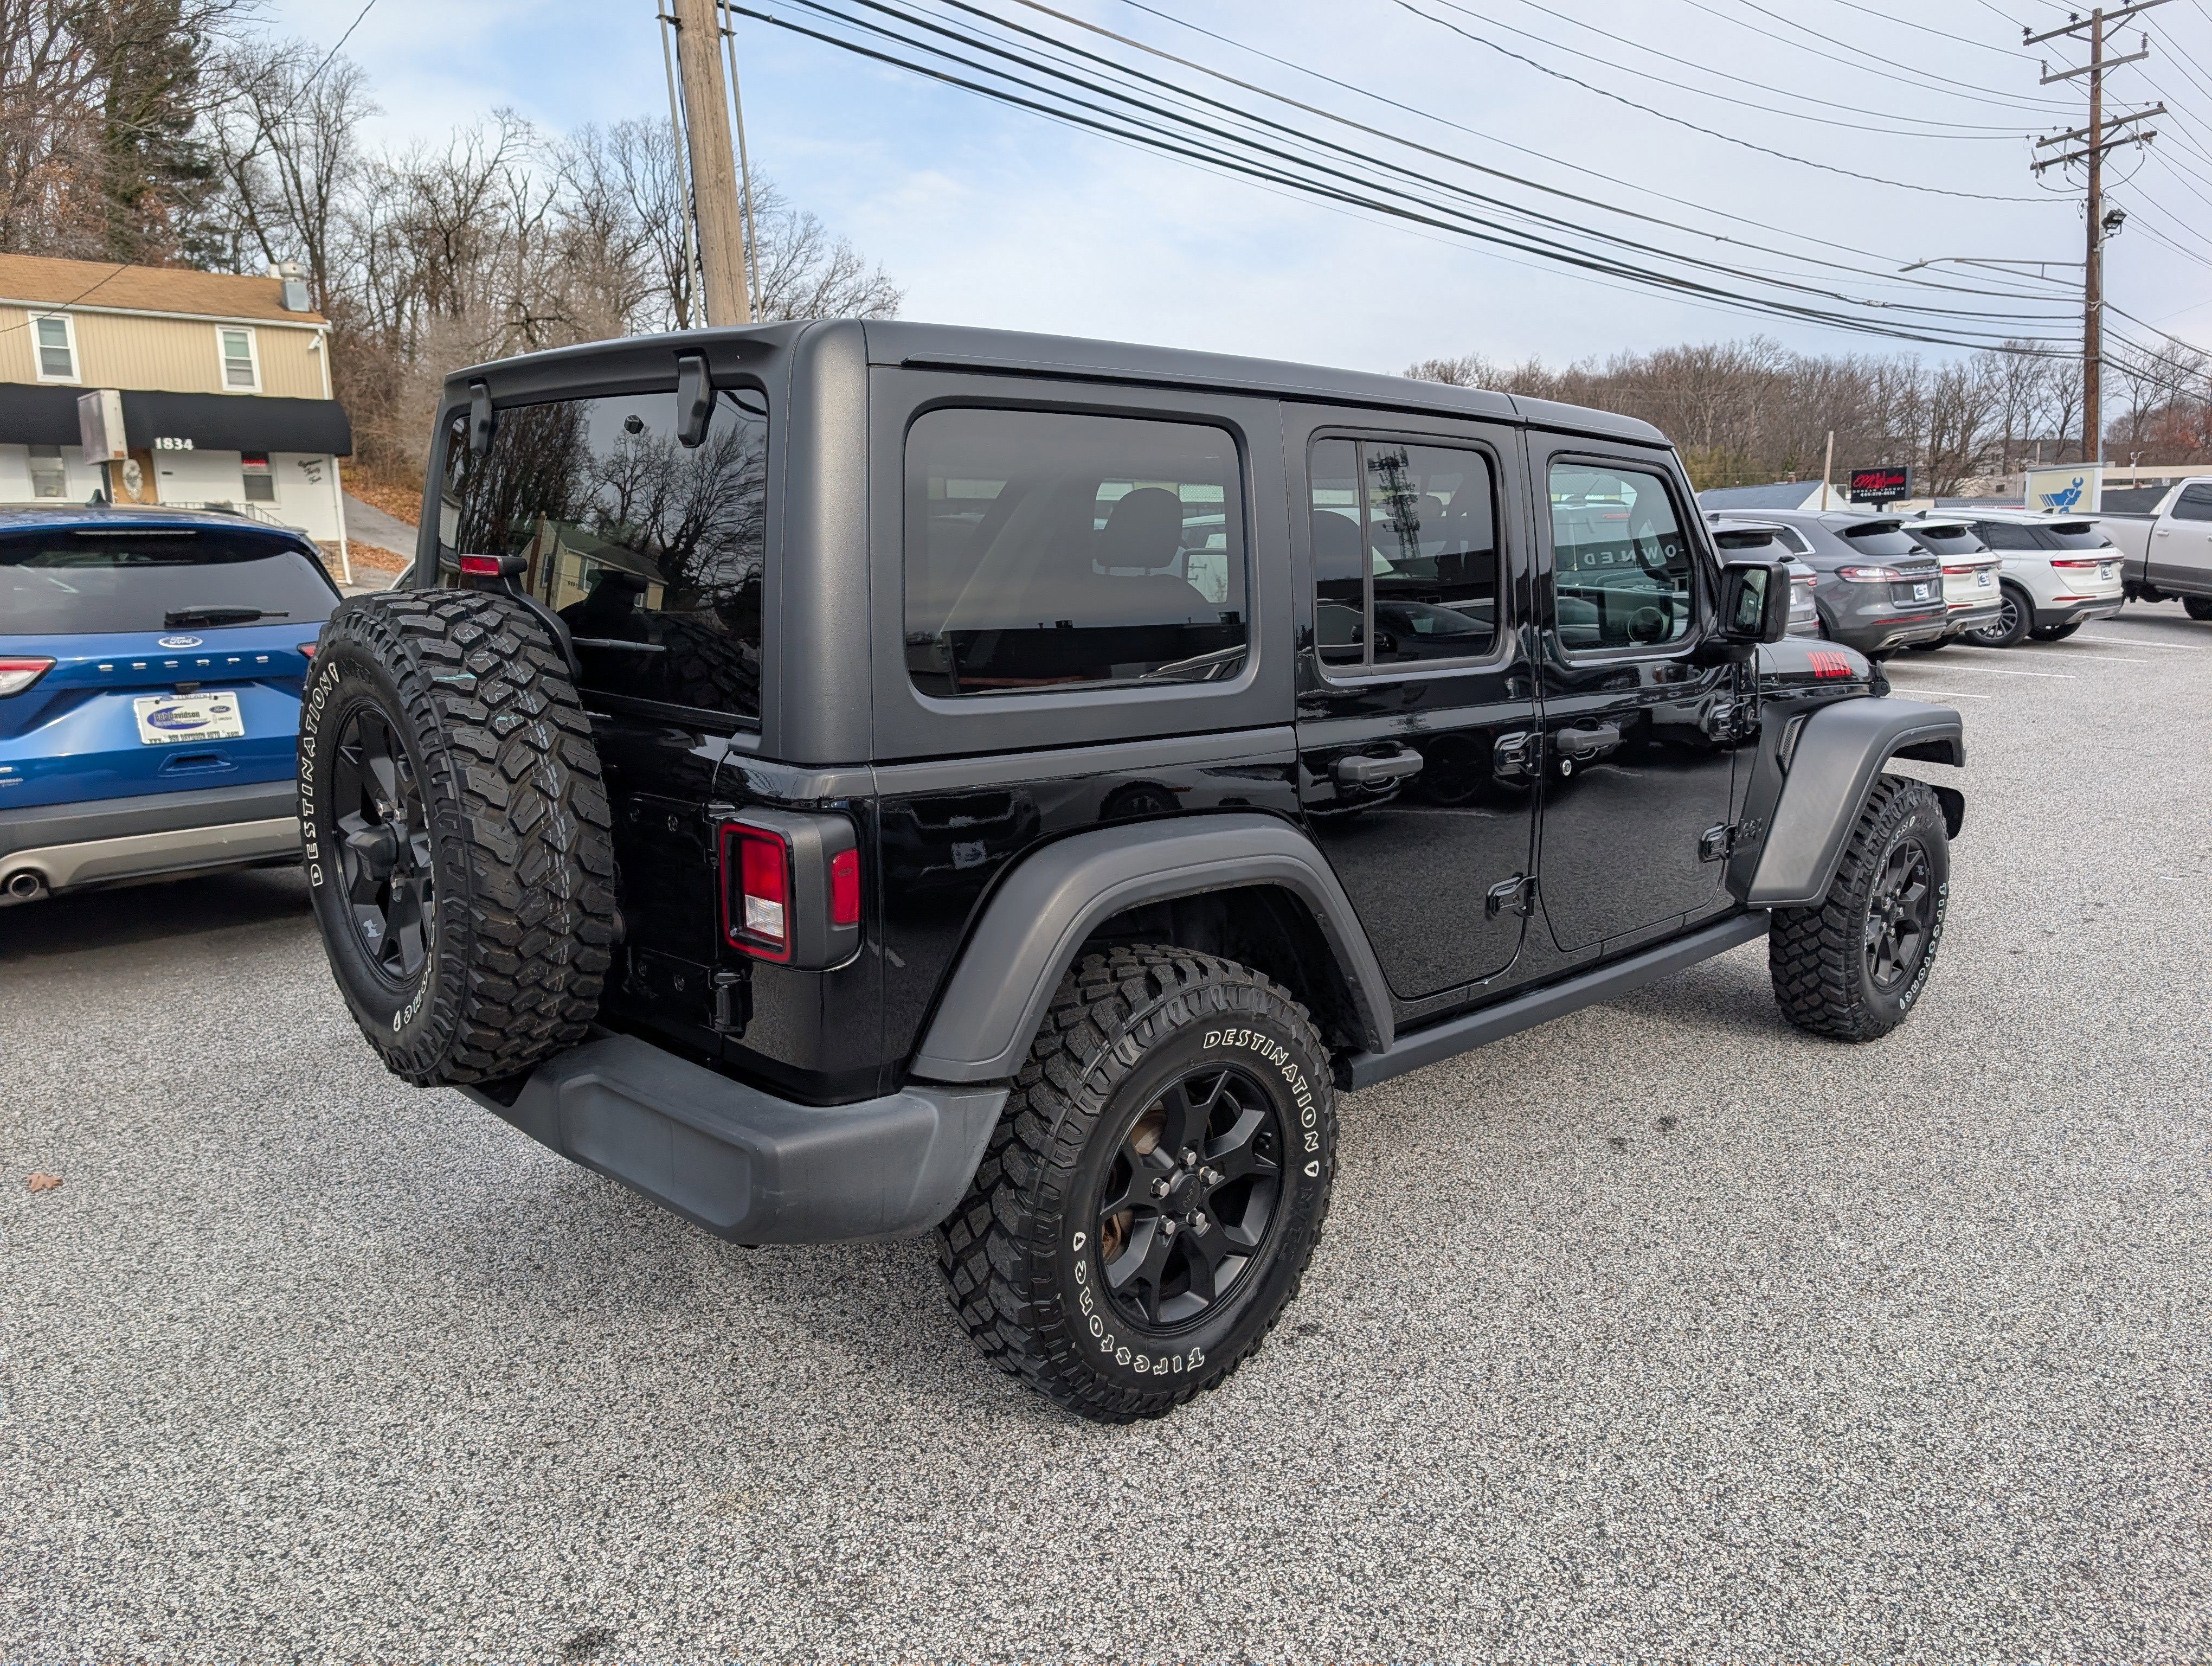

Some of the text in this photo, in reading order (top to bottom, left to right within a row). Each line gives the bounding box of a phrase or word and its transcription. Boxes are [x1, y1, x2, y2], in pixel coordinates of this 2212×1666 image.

[154, 437, 194, 451] 1834
[169, 711, 201, 720] Davidson
[302, 670, 332, 887] DESTINATION
[1203, 1029, 1319, 1152] DESTINATION
